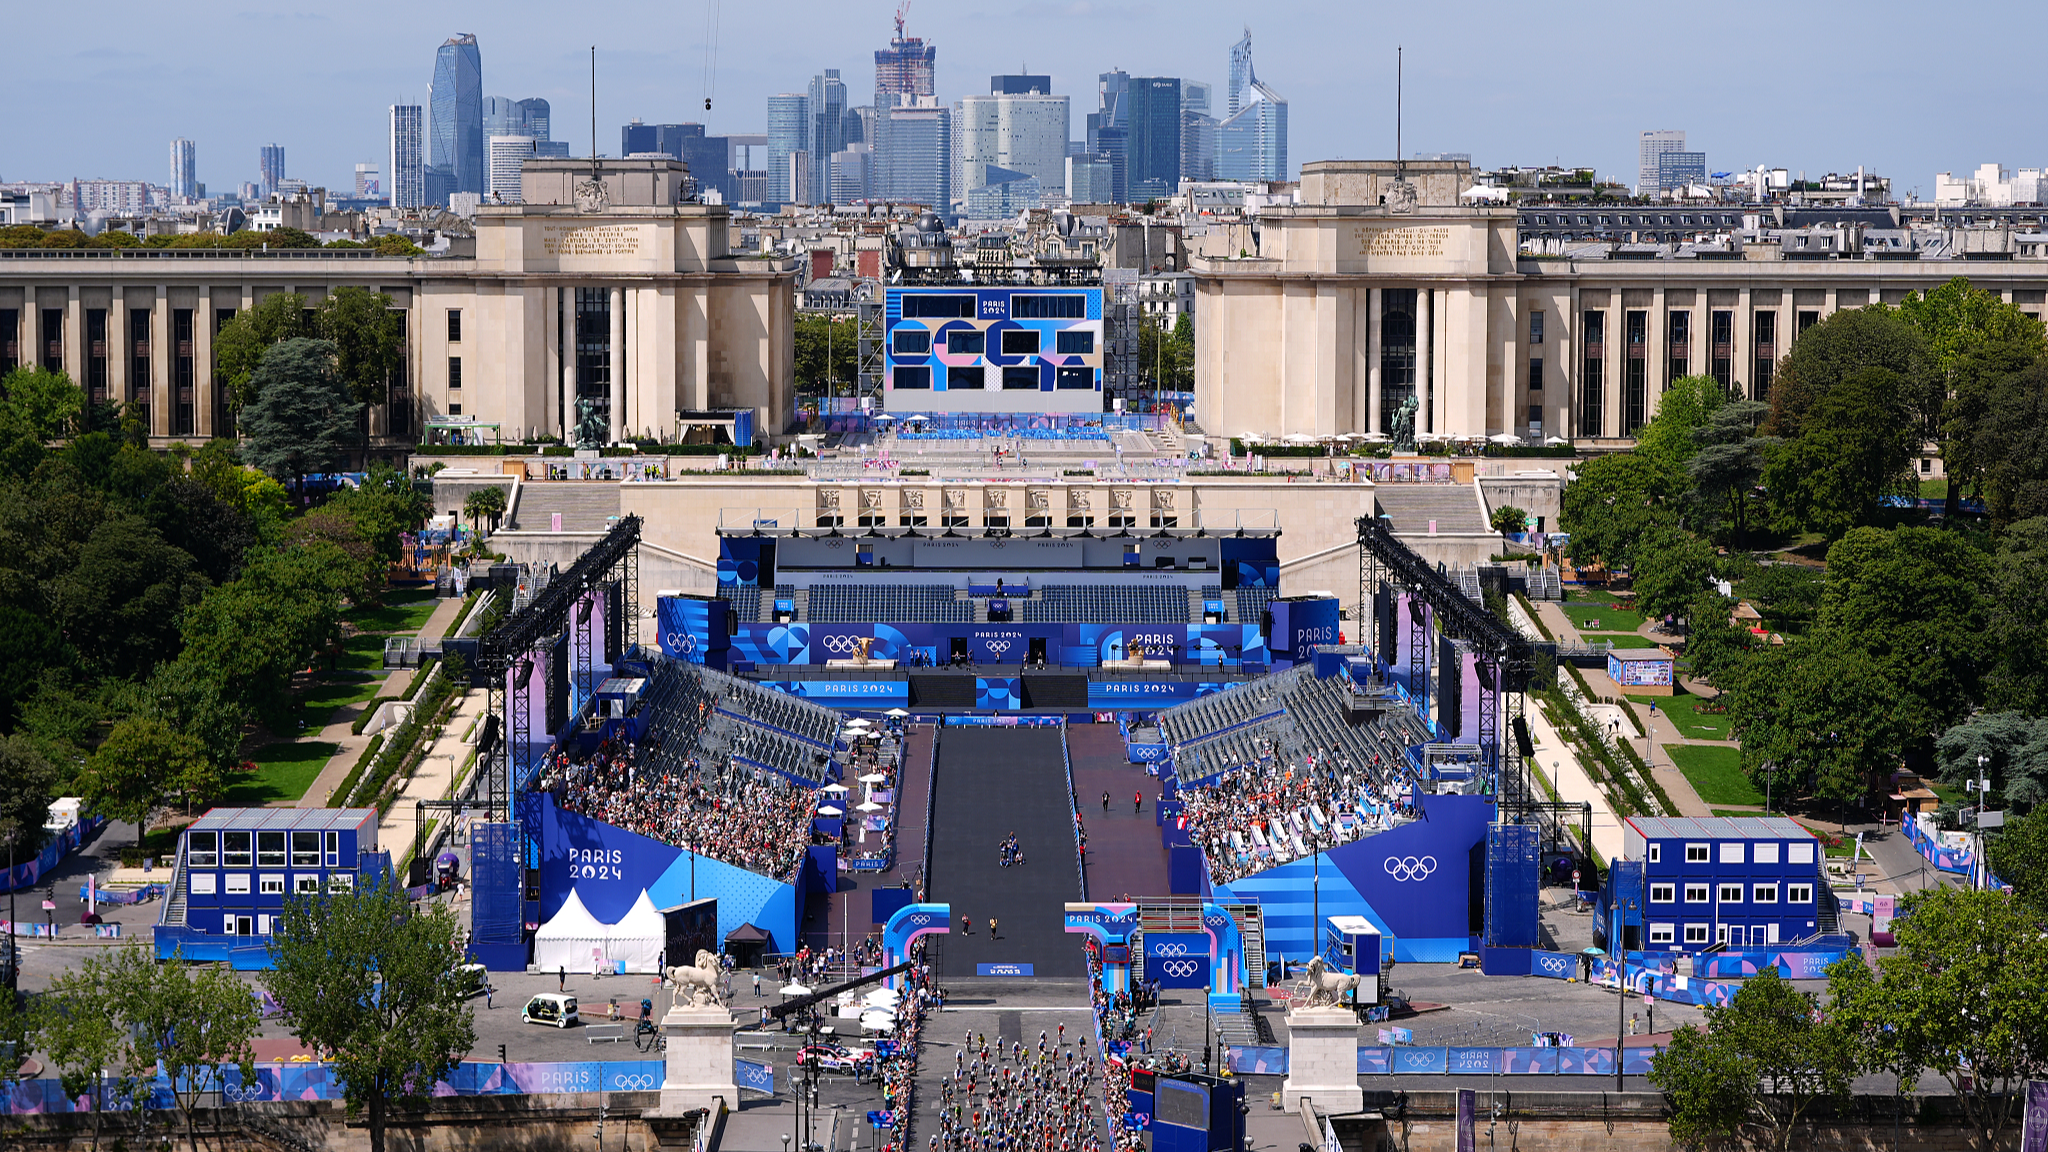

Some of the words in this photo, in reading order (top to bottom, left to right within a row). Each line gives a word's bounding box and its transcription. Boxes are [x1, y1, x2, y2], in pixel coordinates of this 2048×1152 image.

[1136, 634, 1174, 644] PARIS
[1298, 626, 1332, 642] PARIS
[825, 684, 858, 693] PARIS
[862, 684, 893, 693] 2024
[1106, 684, 1140, 692] PARIS
[1144, 684, 1175, 692] 2024
[570, 848, 622, 864] PARIS
[570, 864, 622, 880] 2024
[542, 1072, 589, 1084] PARIS
